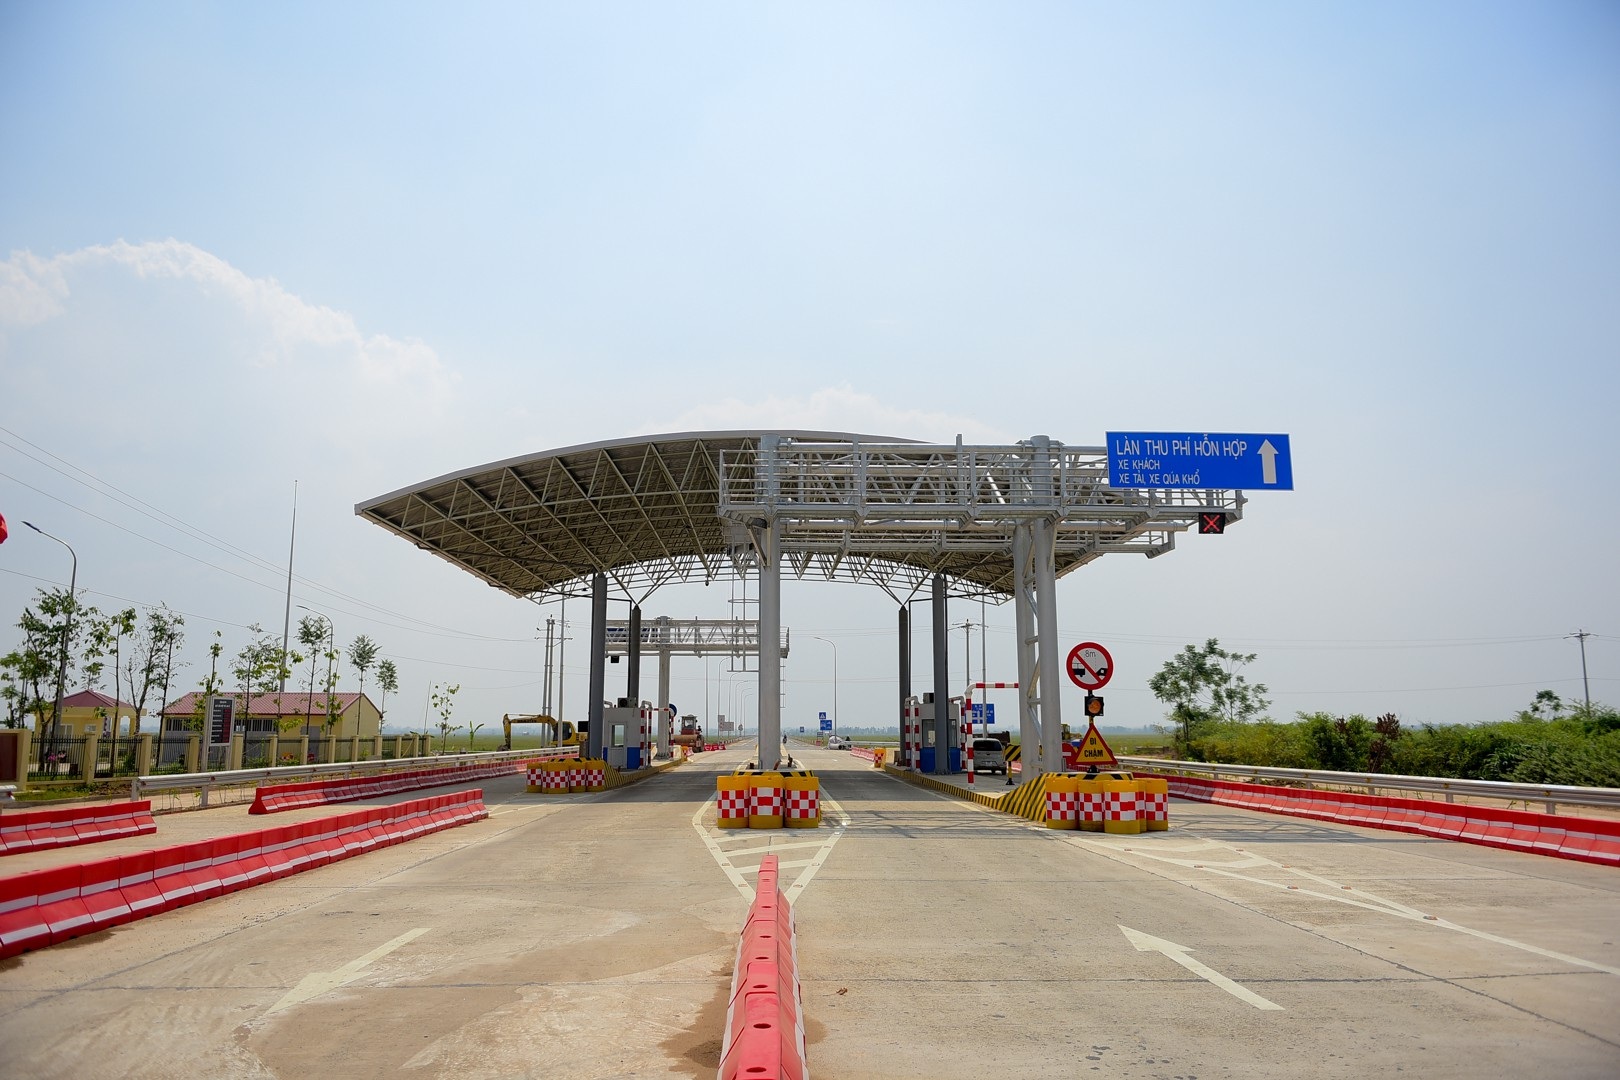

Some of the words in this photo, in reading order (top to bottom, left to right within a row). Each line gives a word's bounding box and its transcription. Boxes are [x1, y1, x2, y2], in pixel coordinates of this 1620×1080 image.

[1116, 435, 1140, 455] LÀN
[1144, 439, 1168, 456] THU
[1172, 436, 1191, 456] PHÍ
[1194, 433, 1220, 457] HỖN
[1222, 438, 1247, 460] HỢP
[1118, 459, 1129, 470] XE
[1132, 457, 1160, 470] KHÁCH
[1119, 473, 1130, 484] XE
[1149, 473, 1161, 484] XE
[1182, 469, 1200, 485] KHỔ
[1085, 650, 1096, 658] 8m
[1090, 737, 1096, 745] ĐI
